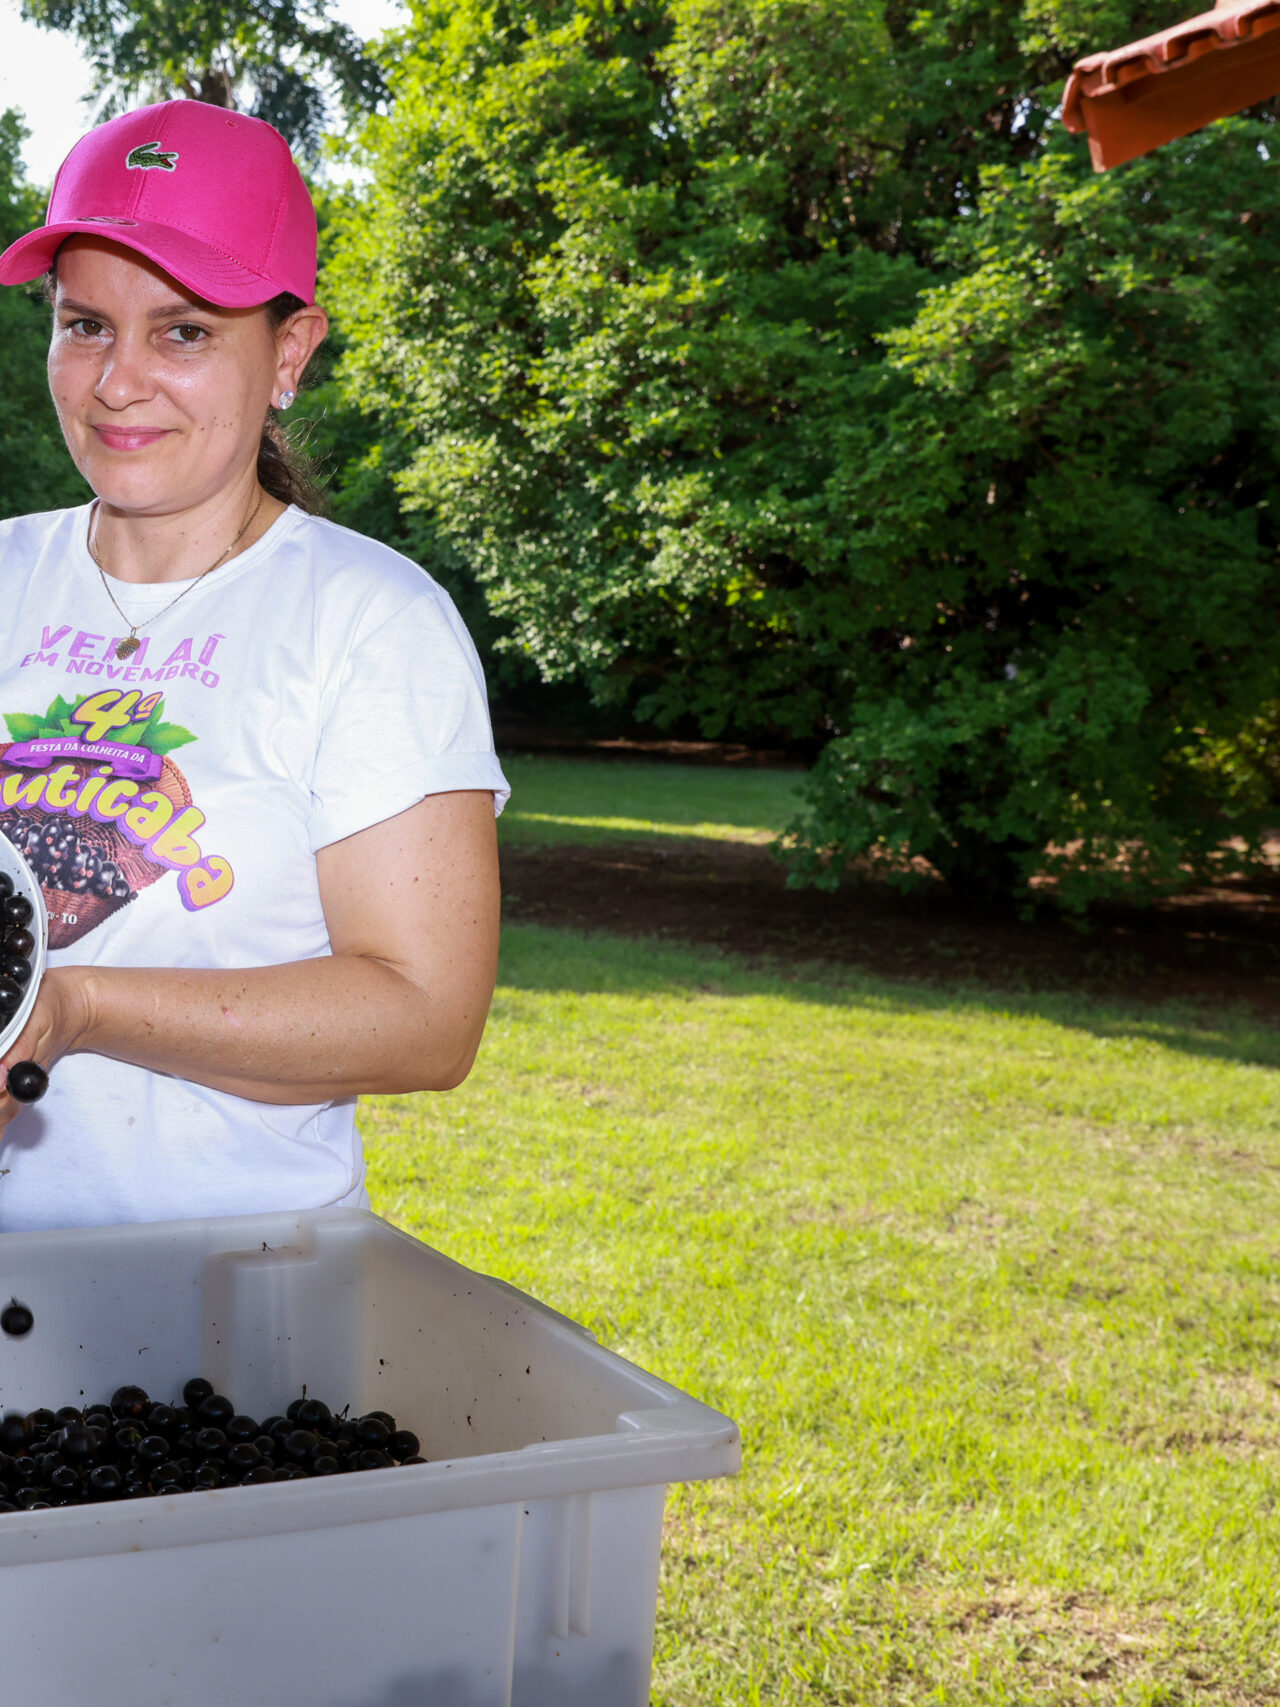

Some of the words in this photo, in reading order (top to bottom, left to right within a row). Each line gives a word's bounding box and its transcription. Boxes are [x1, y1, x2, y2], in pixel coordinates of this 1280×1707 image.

[40, 624, 151, 666] VEM
[162, 633, 227, 667] AÍ
[20, 651, 59, 668] EM
[65, 658, 221, 689] NOVEMBRO
[30, 743, 62, 753] FESTA
[63, 742, 79, 751] DA
[80, 743, 130, 759] COLHEITA
[130, 752, 146, 764] DA
